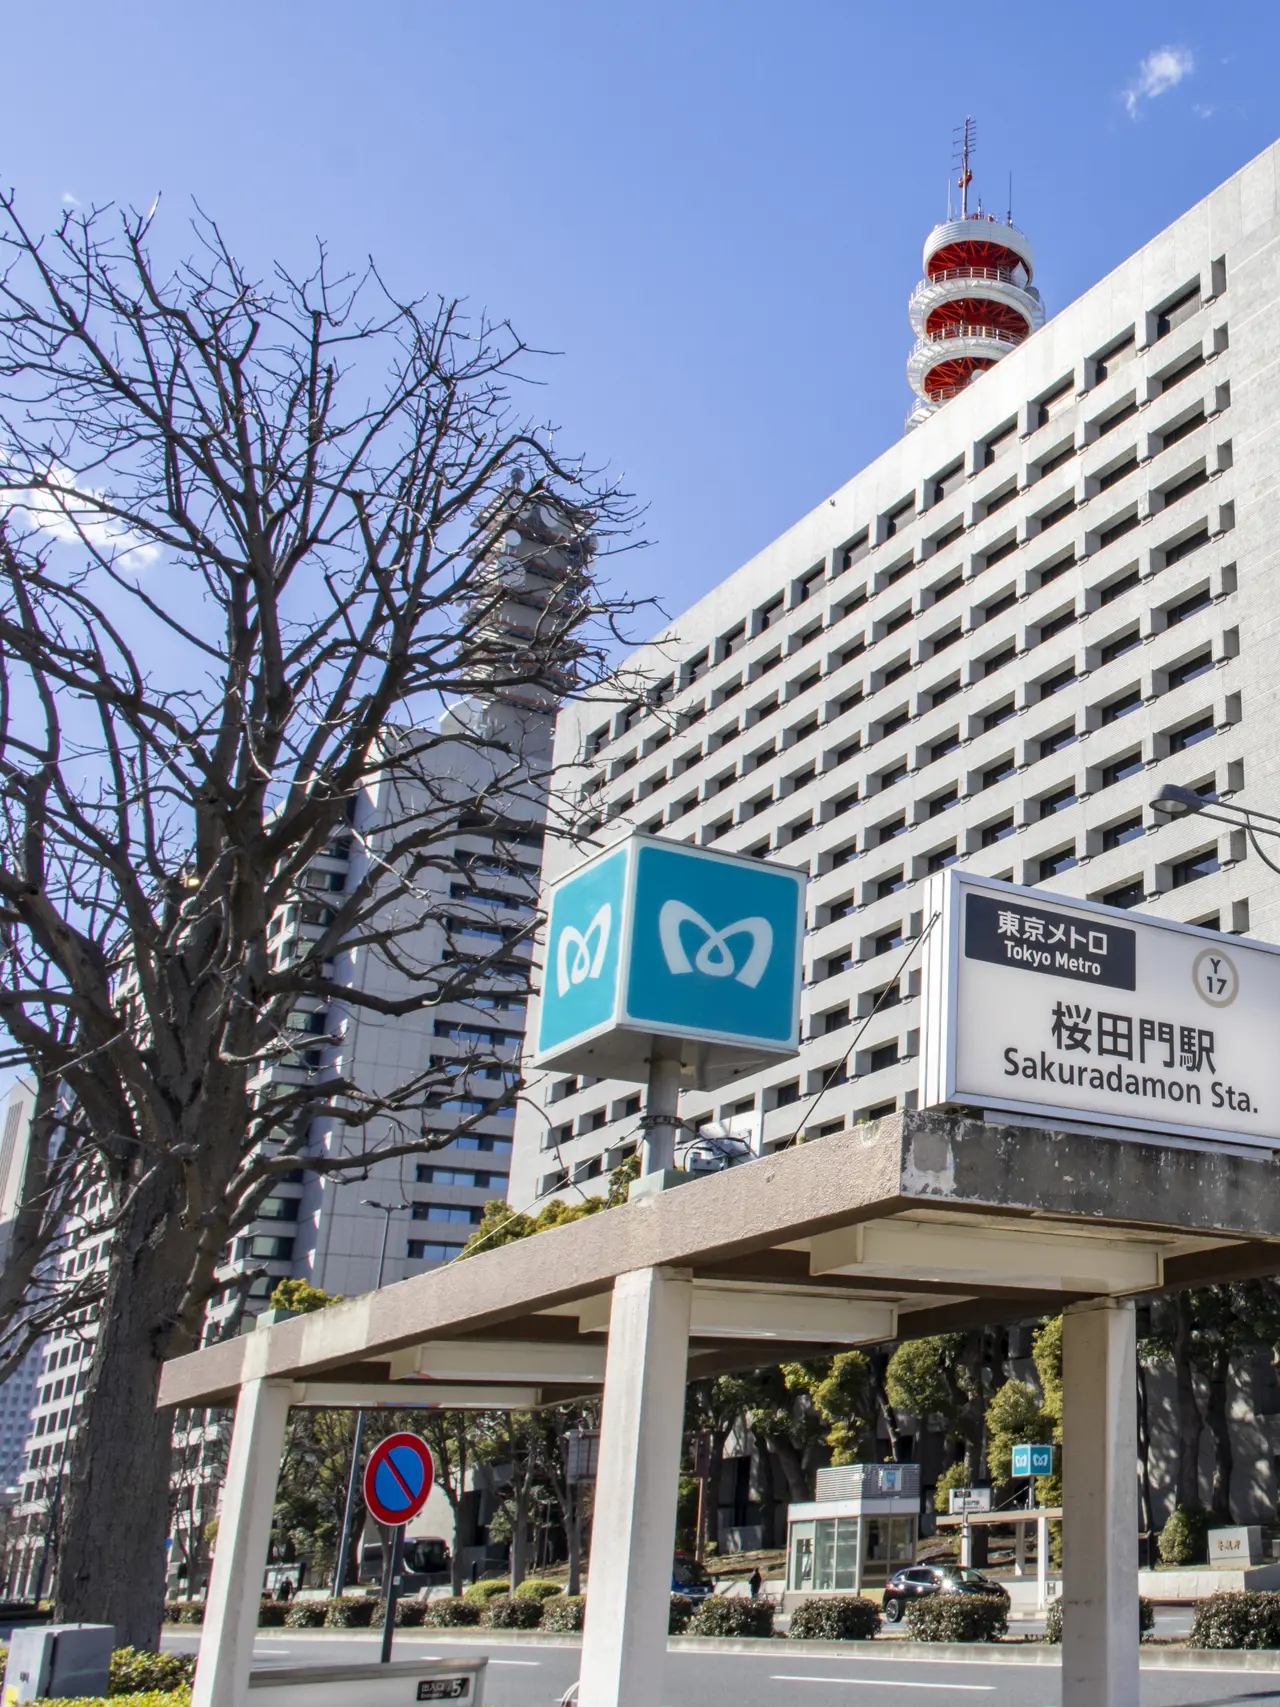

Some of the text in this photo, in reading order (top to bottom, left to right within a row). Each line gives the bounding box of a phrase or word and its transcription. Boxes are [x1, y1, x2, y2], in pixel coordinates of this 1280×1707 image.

[997, 911, 1107, 955] 東京メトロ
[1004, 940, 1101, 976] Tokyo Metro
[1209, 957, 1221, 974] Y
[1206, 976, 1227, 994] 17
[1051, 1001, 1216, 1075] 桜田門駅
[1003, 1047, 1259, 1113] Sakuradamon Sta.
[421, 1682, 445, 1692] 出入口
[450, 1679, 462, 1697] 5
